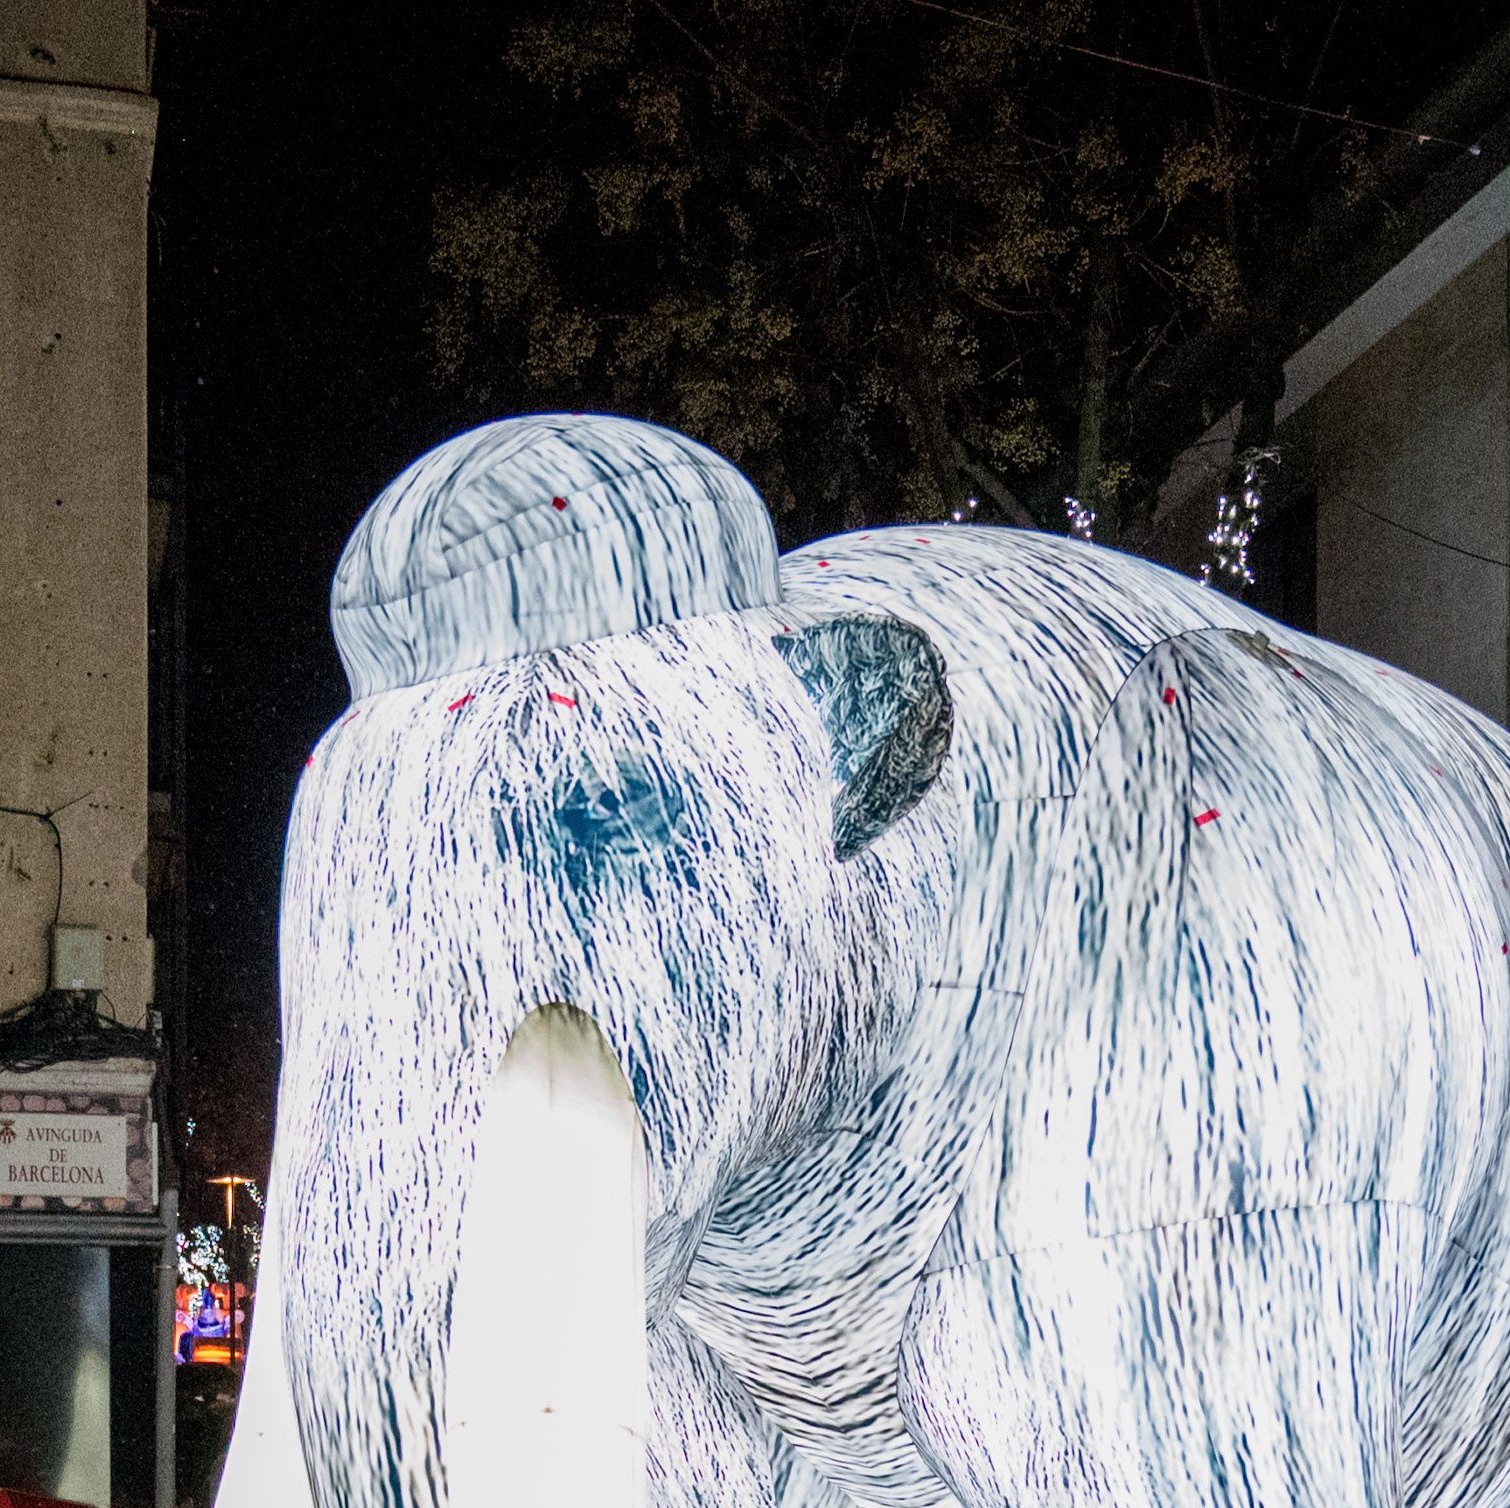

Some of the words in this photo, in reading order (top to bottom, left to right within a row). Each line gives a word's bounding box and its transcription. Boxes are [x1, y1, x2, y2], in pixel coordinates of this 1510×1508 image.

[26, 1127, 102, 1144] AVINGUDA
[49, 1148, 68, 1163] DE
[8, 1164, 104, 1184] BARCELONA
